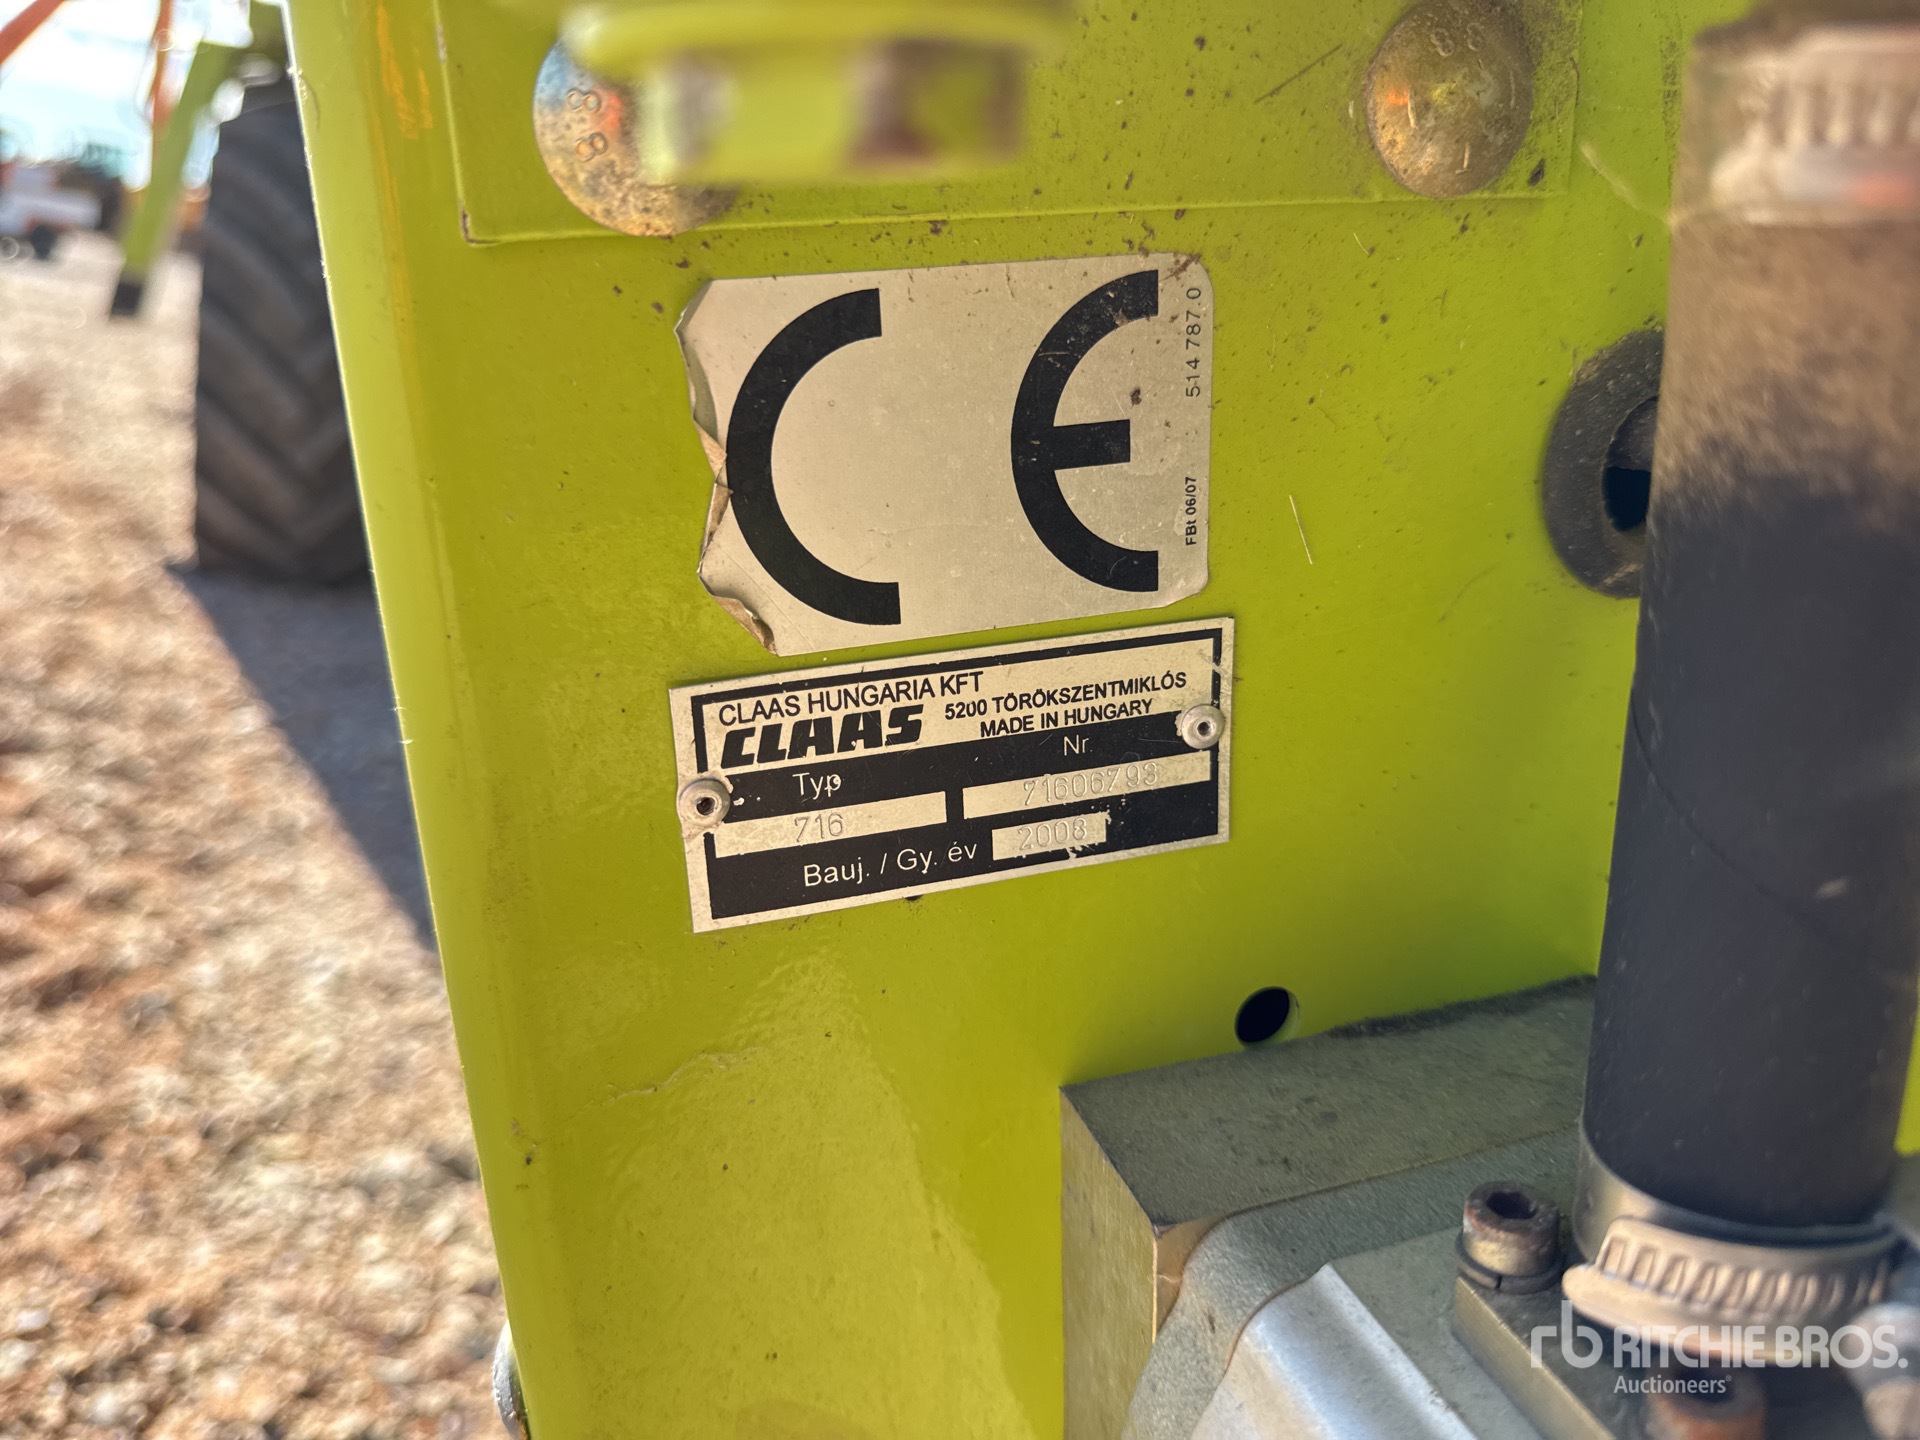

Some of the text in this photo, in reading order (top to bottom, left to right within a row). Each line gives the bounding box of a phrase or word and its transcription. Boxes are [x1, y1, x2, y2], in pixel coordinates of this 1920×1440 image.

[1185, 358, 1201, 397] 514
[1185, 476, 1198, 546] FBt 06/07
[719, 671, 983, 726] CLAAS HUNGARIA KFT
[945, 670, 1187, 720] 5200 TÖRÖKSZENTMIKLÓS
[721, 704, 924, 769] CLAAS
[980, 699, 1153, 738] MADE IN HUNGARY
[792, 772, 842, 800] Typ
[1022, 761, 1158, 806] 71606793
[794, 812, 845, 843] 716
[1017, 817, 1088, 851] 2008
[803, 841, 977, 887] Bauj. / Gy. év
